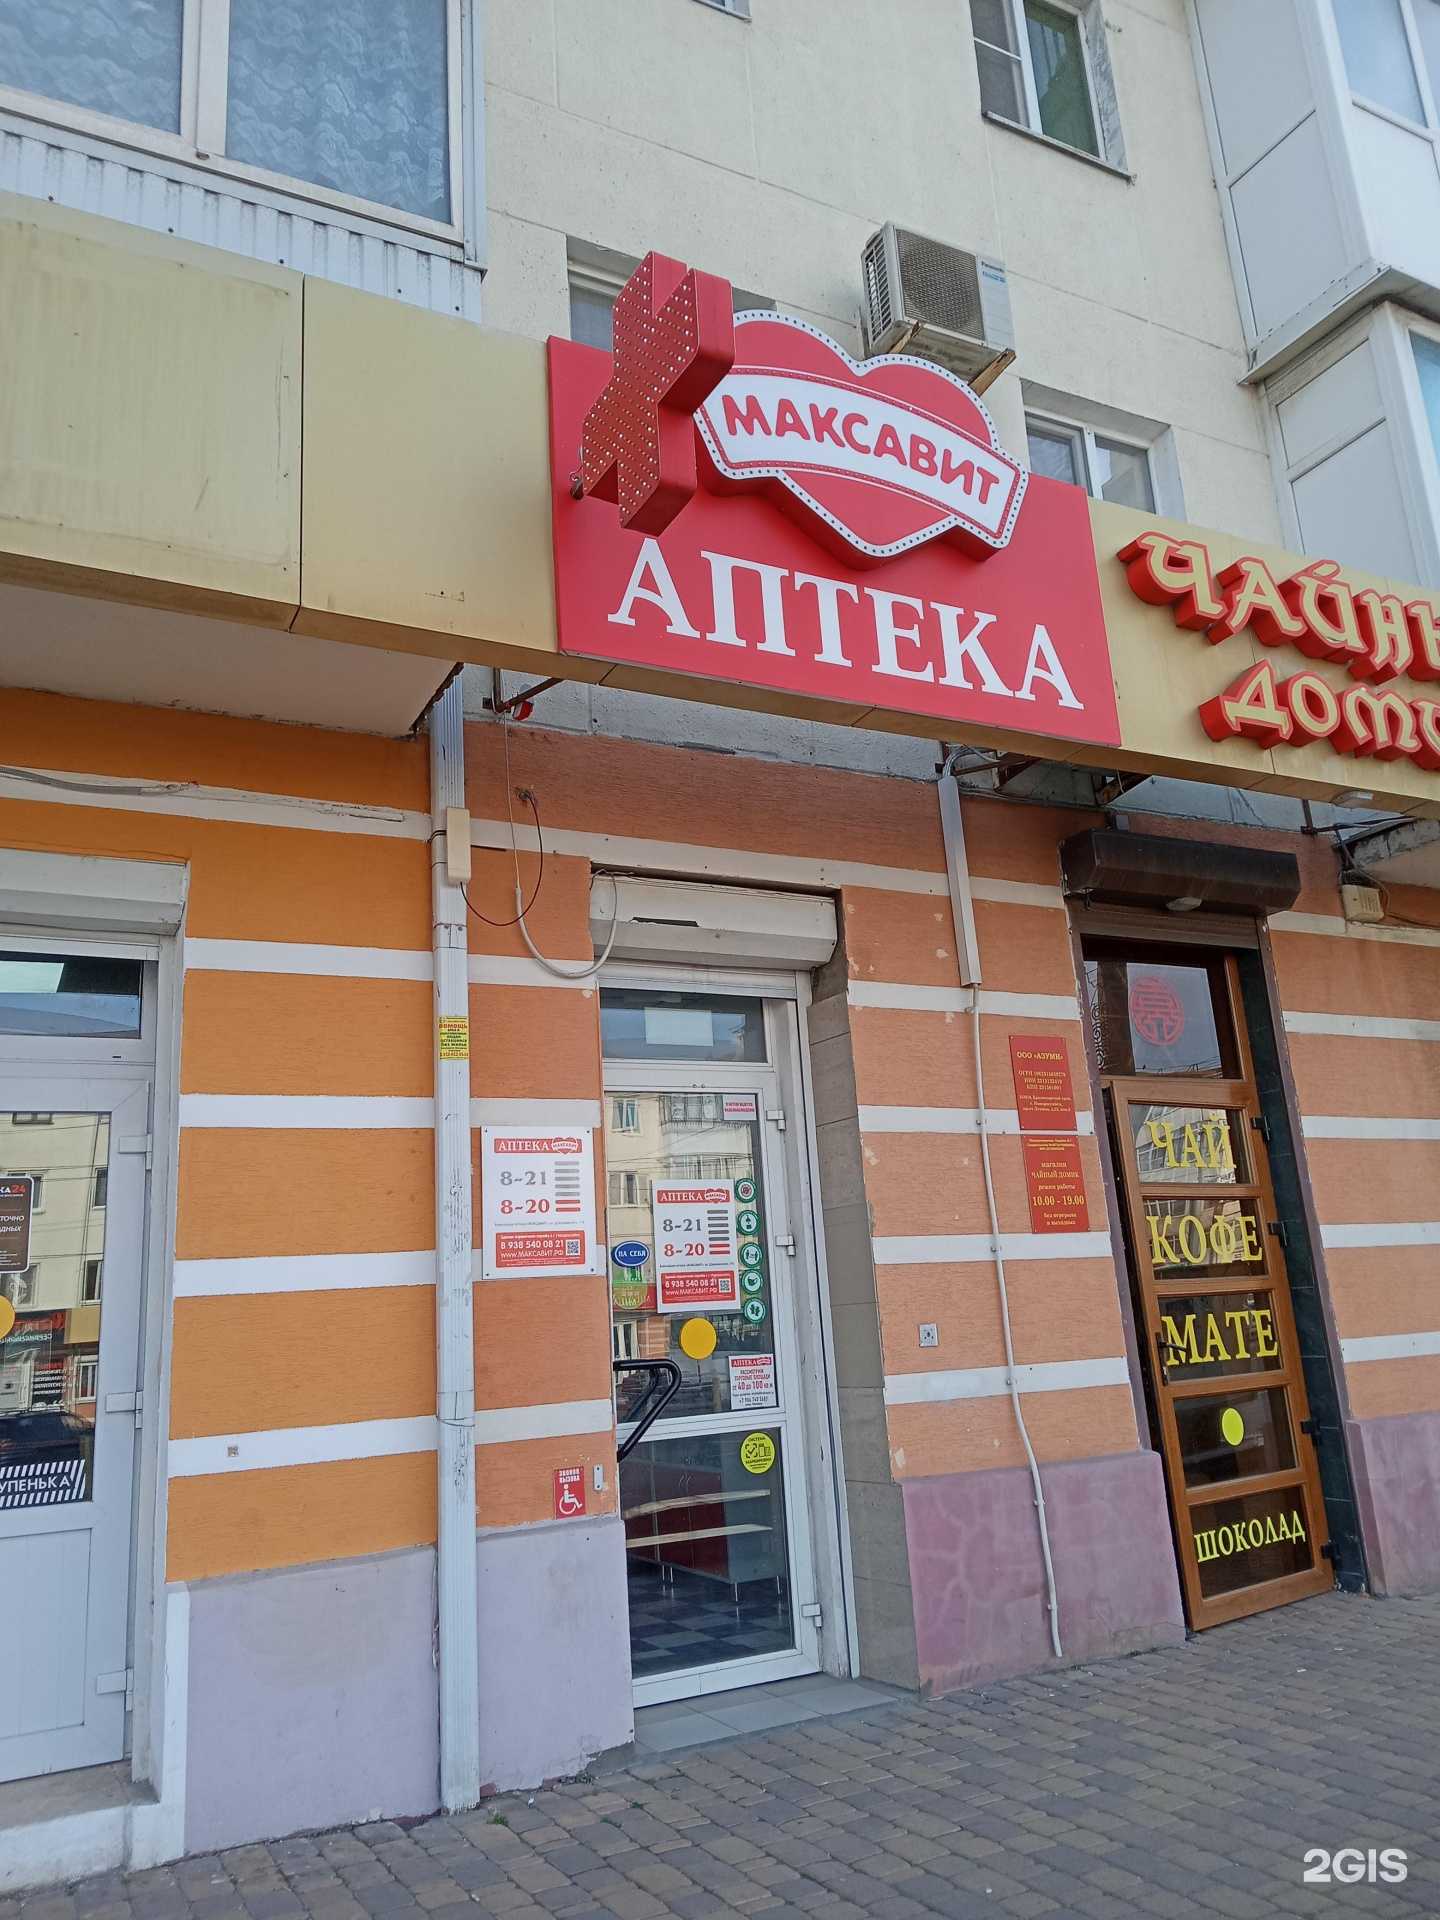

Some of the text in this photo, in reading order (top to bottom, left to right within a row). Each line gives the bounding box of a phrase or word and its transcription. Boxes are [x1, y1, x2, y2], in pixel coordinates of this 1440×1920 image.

[721, 394, 1000, 504] МАКСАВИТ
[607, 537, 1084, 710] АПТЕКА
[1016, 1051, 1032, 1059] ООО
[499, 1141, 550, 1151] АПТЕКА
[1145, 1112, 1236, 1169] ЧАЙ
[11, 1184, 26, 1193] 24
[660, 1192, 704, 1201] АПТЕКА
[1033, 1196, 1055, 1206] 10.00
[1062, 1195, 1085, 1205] 19.00
[508, 1241, 524, 1249] 938
[525, 1240, 541, 1248] 540
[555, 1240, 564, 1248] 21
[1146, 1215, 1263, 1264] КОФЕ
[1161, 1309, 1278, 1367] МАТЕ
[1194, 1510, 1306, 1563] ШОКОЛАД
